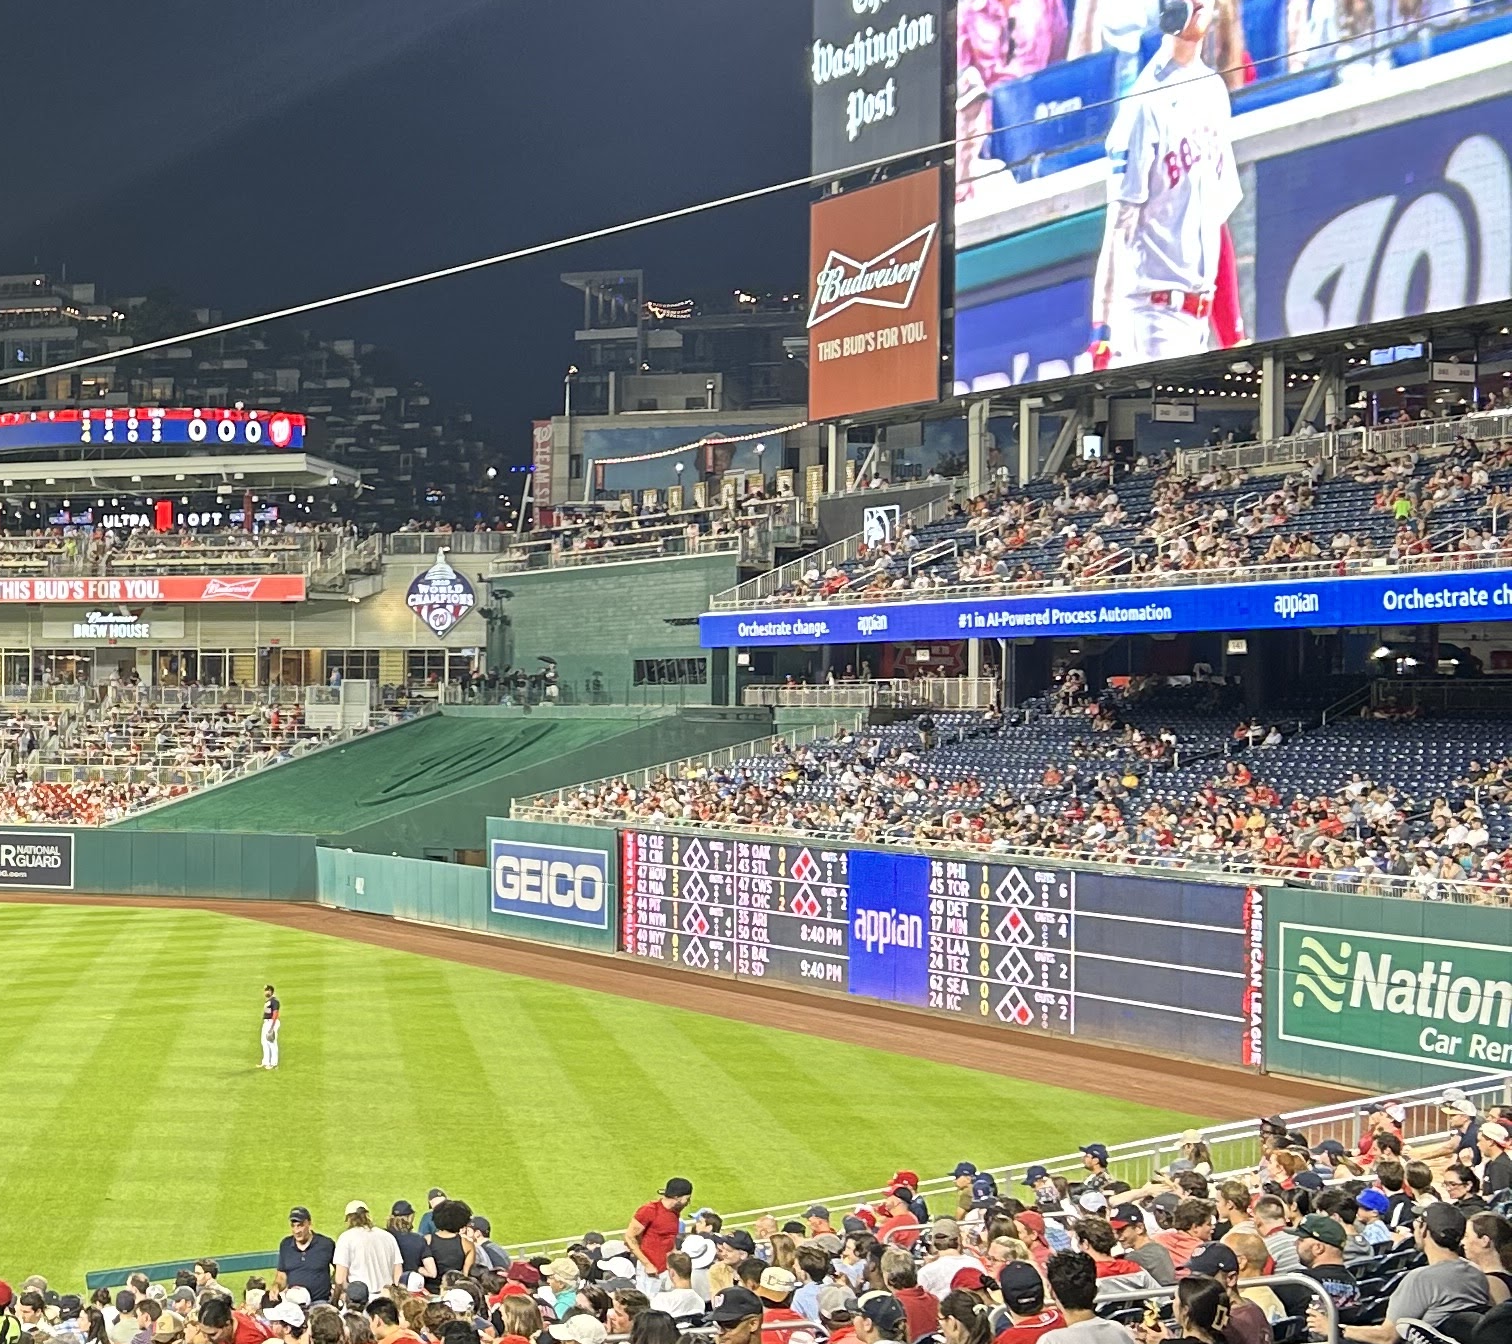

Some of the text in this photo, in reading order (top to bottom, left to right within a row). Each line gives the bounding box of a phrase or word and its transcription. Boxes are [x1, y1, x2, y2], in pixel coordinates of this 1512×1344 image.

[811, 13, 936, 85] Washington
[846, 77, 897, 142] Post
[817, 258, 921, 304] Budweiser
[817, 320, 927, 362] THIS BUD'S FOR YOU.
[189, 419, 207, 442] 0
[218, 419, 236, 442] 0
[245, 419, 262, 443] 0
[102, 514, 150, 528] ULTRA
[34, 580, 85, 599] BUD'S
[88, 580, 121, 599] FOR
[124, 580, 165, 599] YOU.
[418, 584, 464, 594] WORLD
[407, 593, 474, 607] CHAMPIONS
[738, 621, 791, 638] Orchestrate
[793, 619, 830, 636] change.
[857, 613, 888, 636] appian
[958, 614, 974, 629] #1
[975, 613, 985, 628] in
[987, 610, 1050, 627] AI-Powered
[1052, 608, 1097, 625] Process
[1099, 602, 1172, 623] Automation
[1273, 591, 1319, 619] appian
[1382, 586, 1489, 611] Orchestrate
[73, 622, 150, 638] BREW HOUSE
[16, 845, 62, 856] NATIONAL
[16, 855, 62, 869] GUARD
[751, 860, 768, 875] STL
[778, 863, 786, 877] 4
[930, 861, 944, 877] 16
[981, 865, 989, 881] 1
[496, 856, 604, 913] GEICO
[751, 879, 773, 894] CWS
[929, 878, 989, 899] 45 TOR 0
[1059, 884, 1068, 899] 6
[751, 895, 771, 909] CHC
[778, 897, 786, 911] 2
[929, 899, 989, 921] 49 DET 2
[751, 928, 770, 943] COL
[800, 924, 842, 946] 8:40 PM
[854, 908, 923, 954] appian
[930, 916, 944, 931] 17
[980, 923, 989, 939] 0
[1058, 923, 1068, 939] 4
[929, 937, 989, 959] 52 LAA 0
[751, 961, 765, 976] SD
[800, 960, 842, 983] 9:40 PM
[946, 956, 969, 974] TEX
[1059, 964, 1068, 979] 2
[946, 977, 969, 996] SEA
[1250, 890, 1263, 1065] AMERICAN LEAGUE
[946, 995, 962, 1011] KC
[1059, 1005, 1068, 1020] 2
[1419, 1027, 1462, 1056] Car
